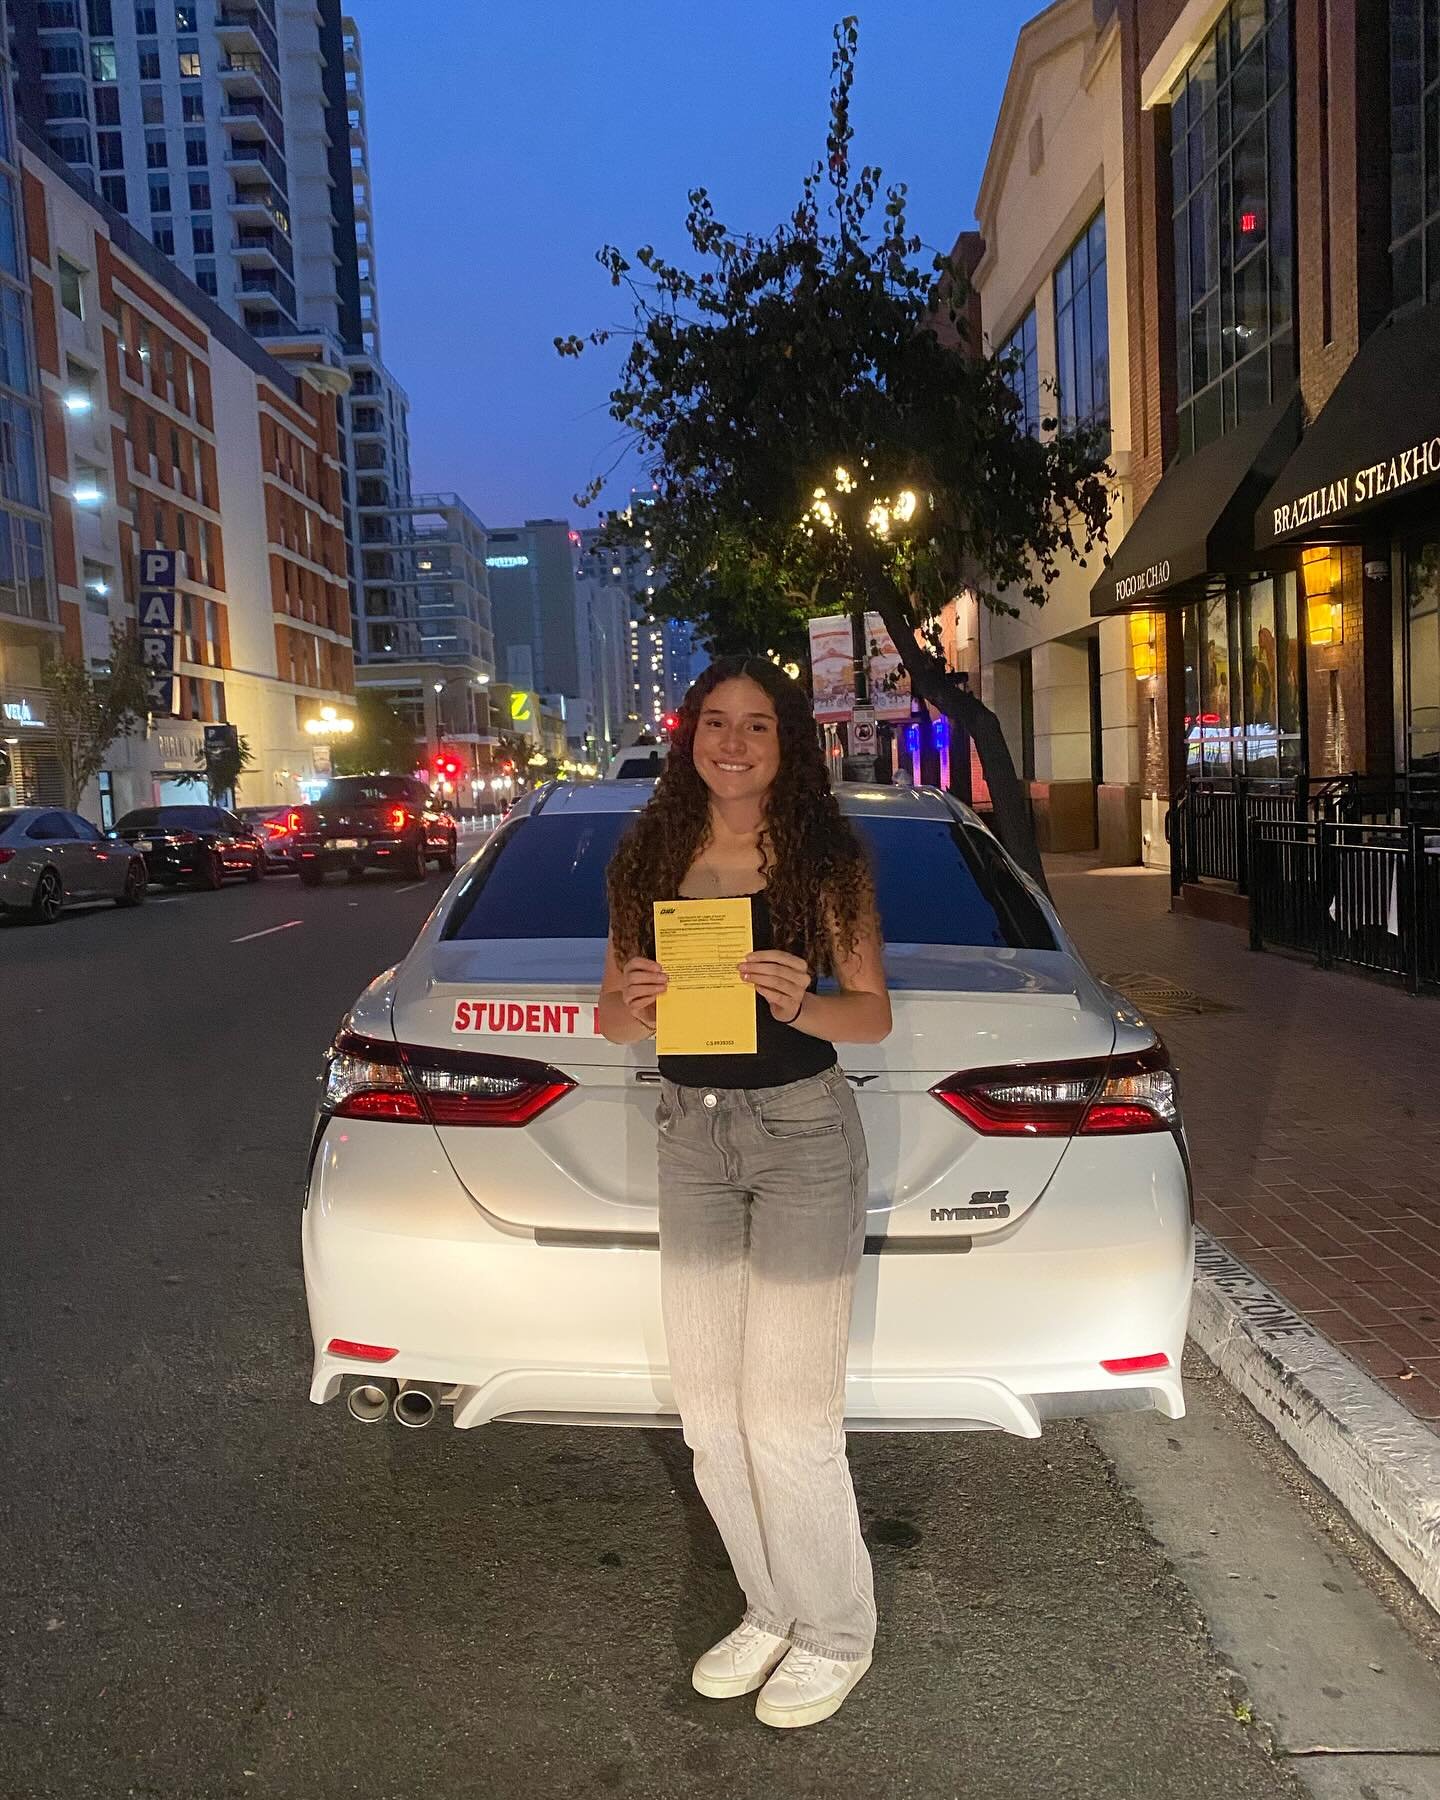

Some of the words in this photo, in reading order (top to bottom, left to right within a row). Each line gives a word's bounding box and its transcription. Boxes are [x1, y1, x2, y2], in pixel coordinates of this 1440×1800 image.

[1273, 477, 1348, 535] BRAZILIAN
[1115, 575, 1137, 602] FOGO
[1137, 573, 1146, 591] DE
[144, 554, 170, 706] PARK
[454, 1001, 579, 1034] STUDENT
[969, 1190, 1010, 1205] SE
[930, 1207, 997, 1222] HYBRID
[1228, 1293, 1316, 1341] ZONE
